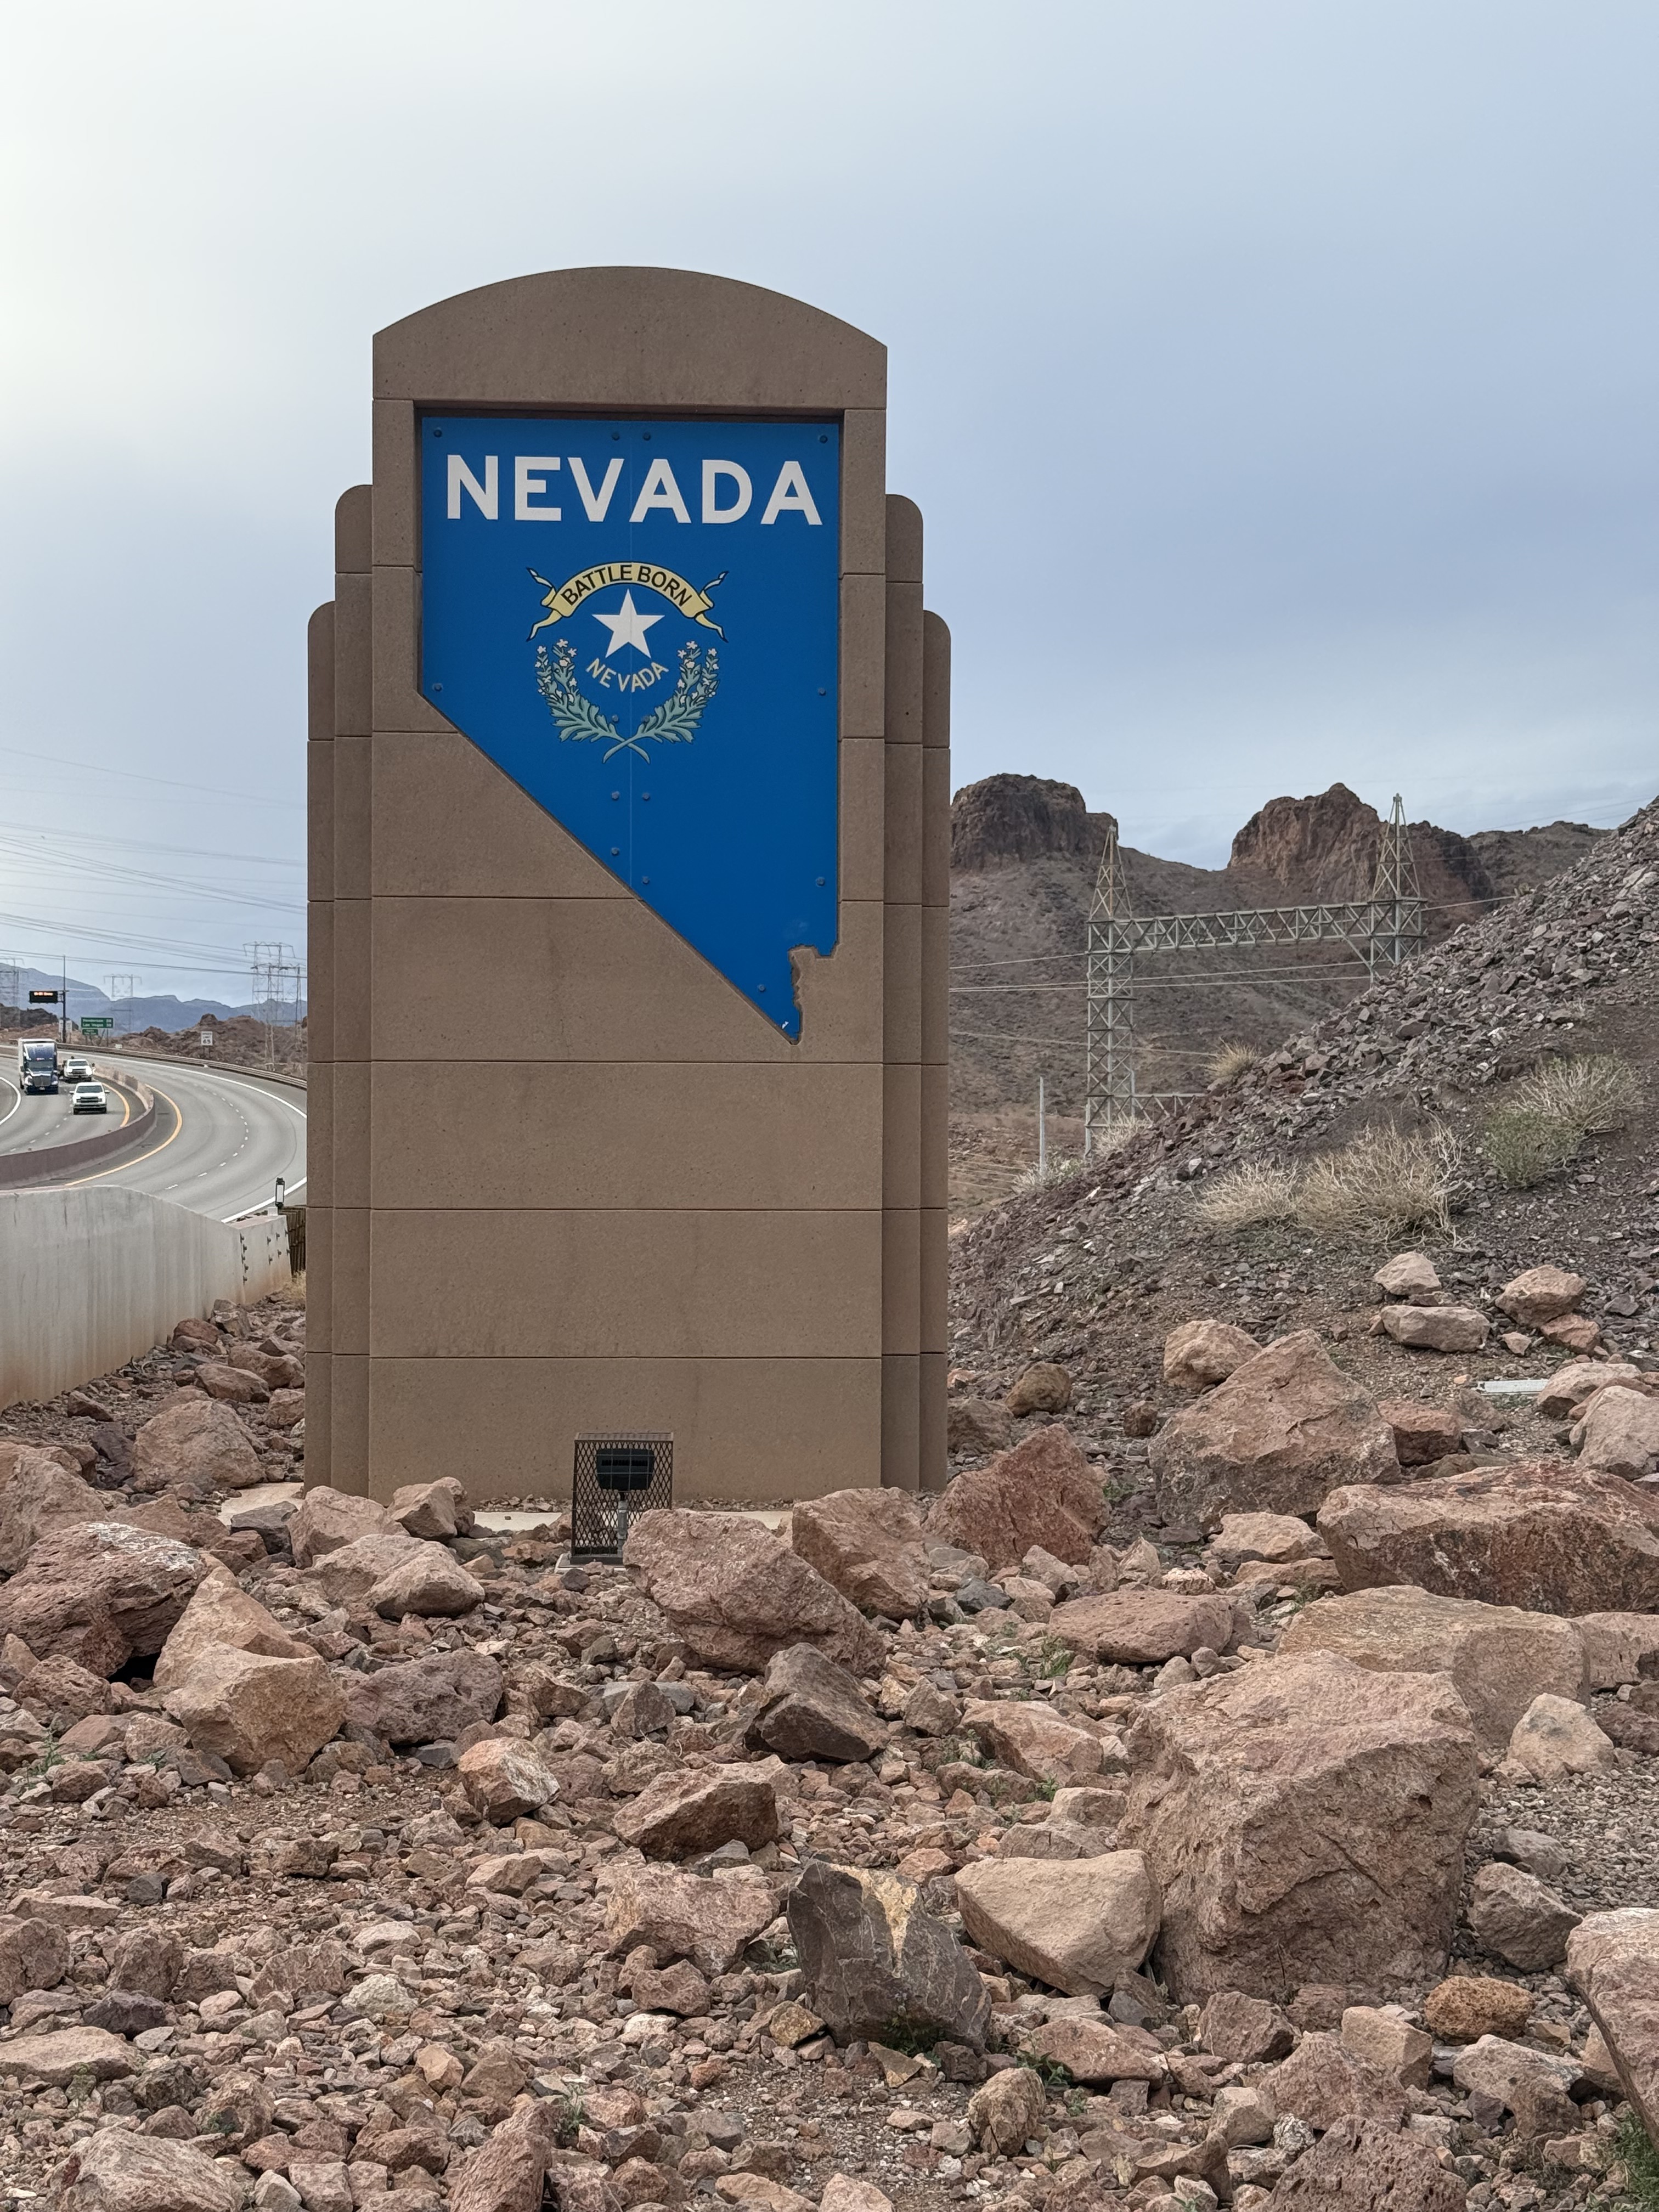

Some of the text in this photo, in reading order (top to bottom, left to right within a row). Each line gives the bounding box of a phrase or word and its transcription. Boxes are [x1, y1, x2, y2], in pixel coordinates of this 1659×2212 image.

[447, 454, 822, 525] NEVADA
[560, 564, 692, 607] BATTLE BORN
[586, 658, 669, 693] NEVADA
